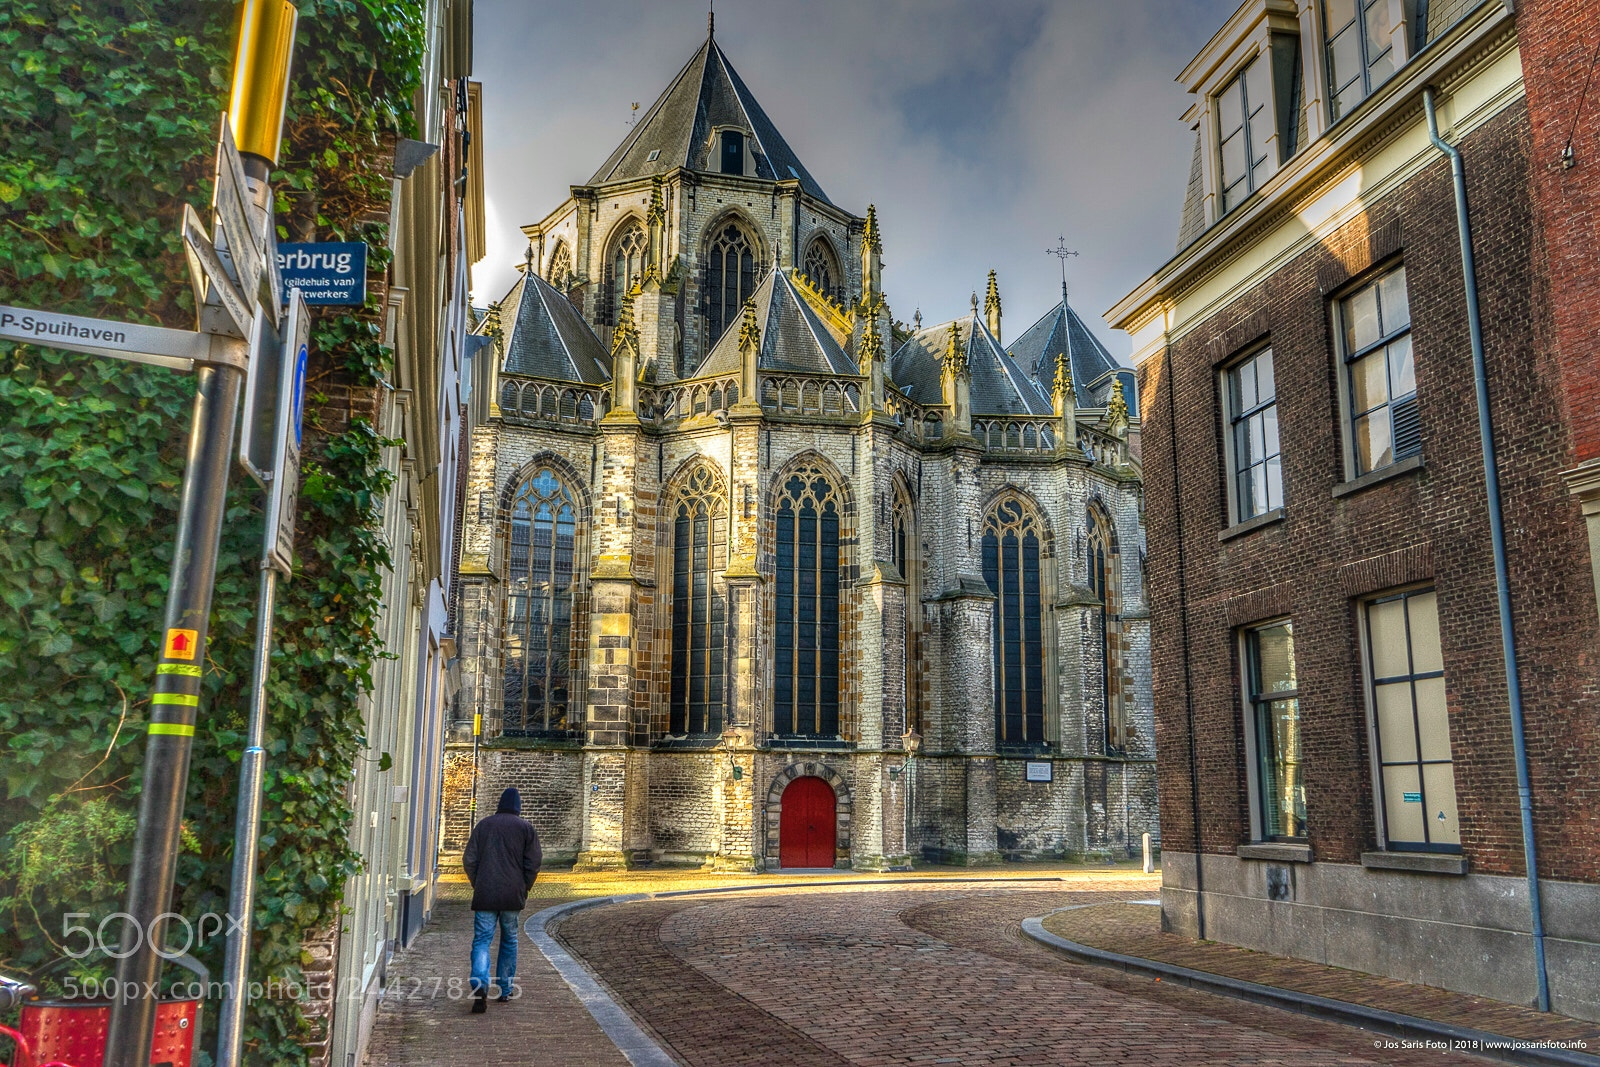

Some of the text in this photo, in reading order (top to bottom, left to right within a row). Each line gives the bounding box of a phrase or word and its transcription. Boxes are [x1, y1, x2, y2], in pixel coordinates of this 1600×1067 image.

[284, 277, 355, 288] (gildehuis van)
[0, 313, 126, 343] P-Spuihaven
